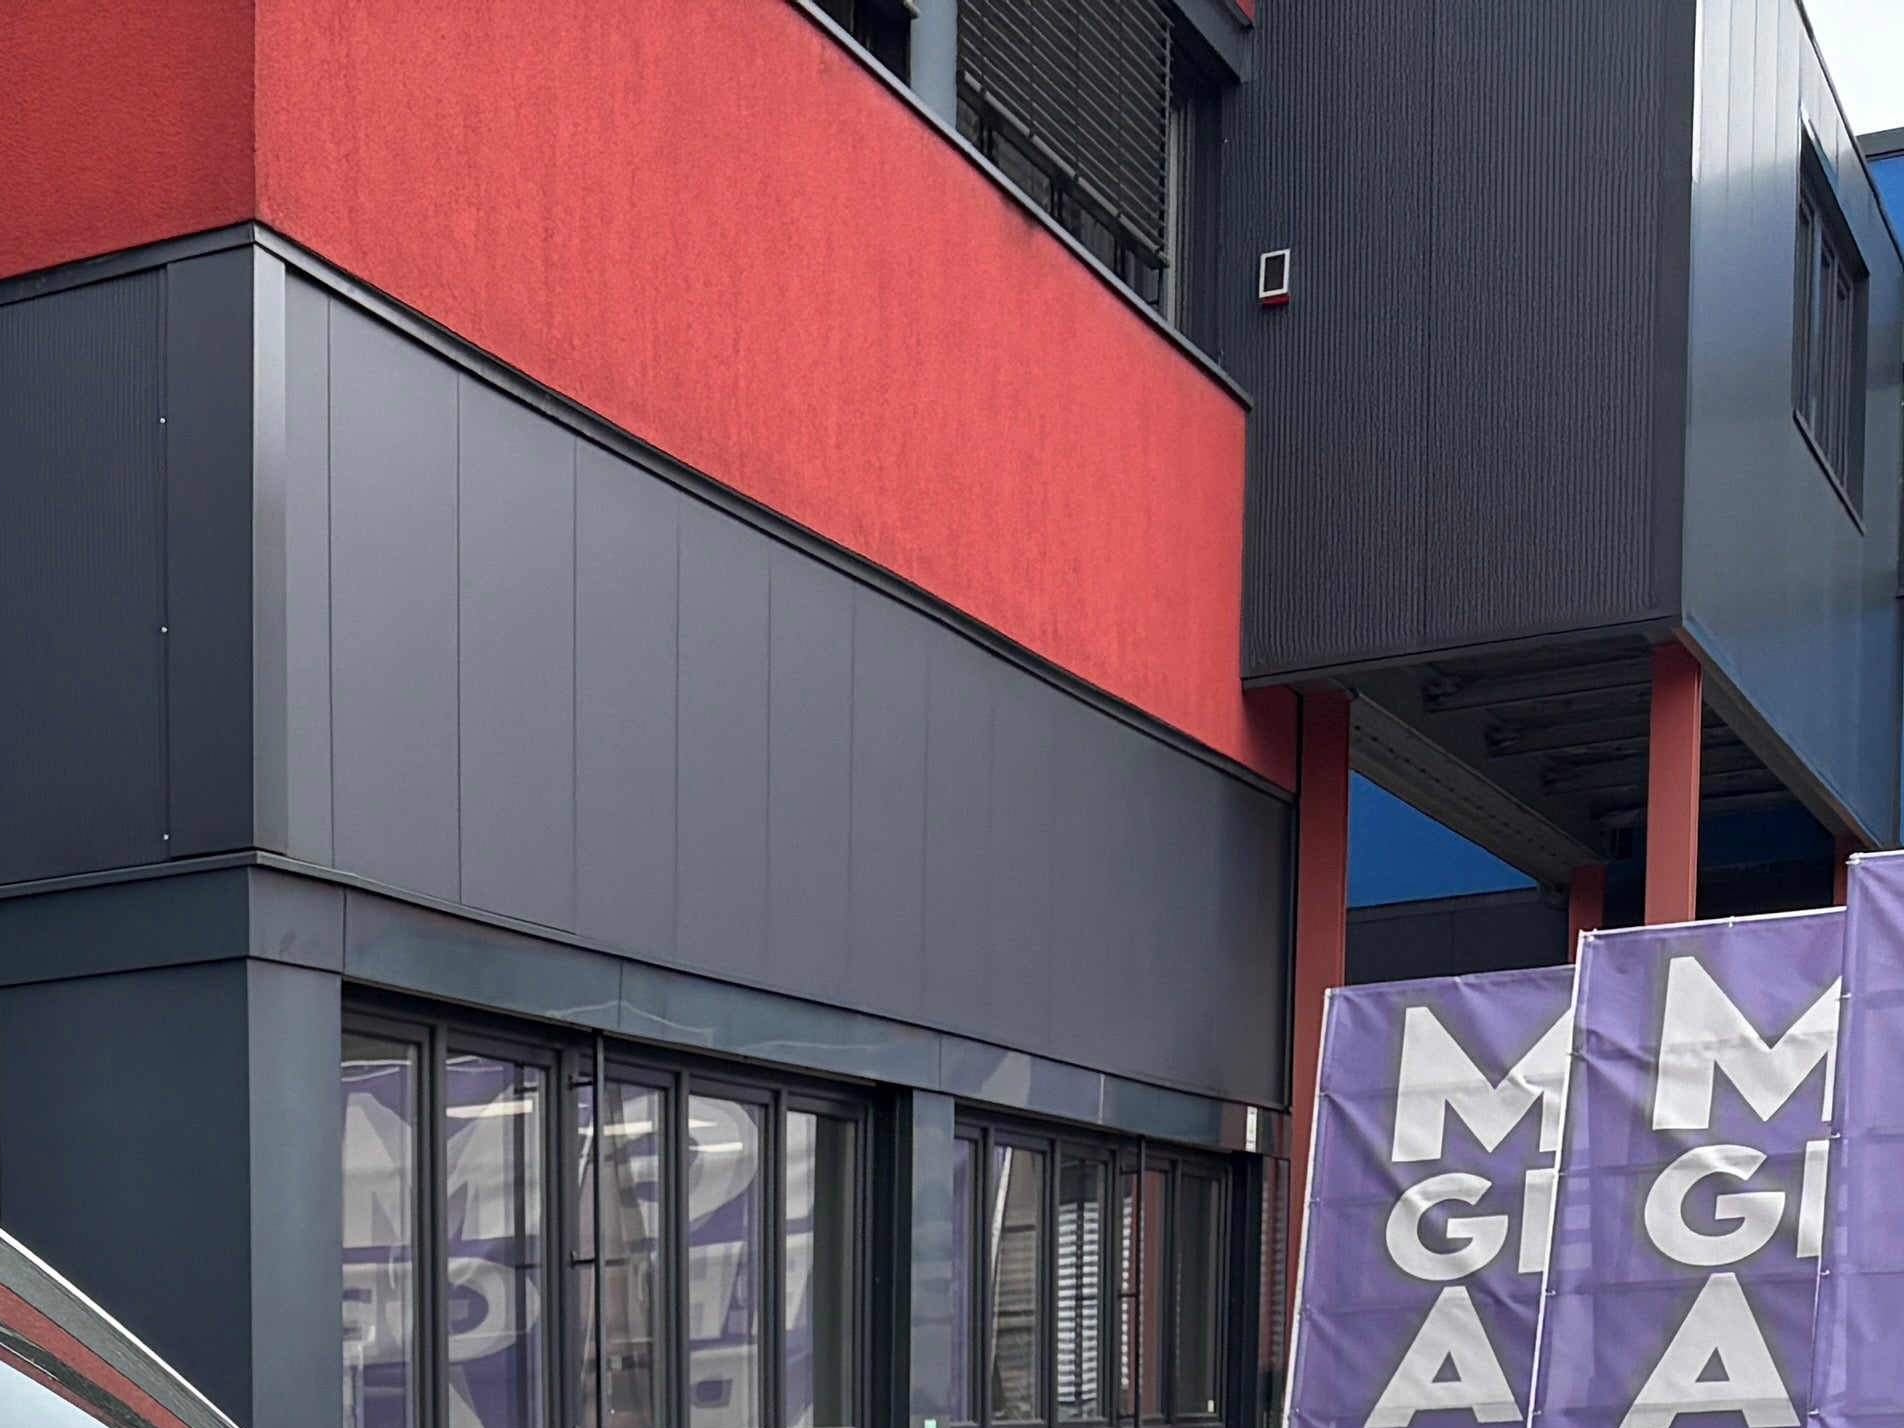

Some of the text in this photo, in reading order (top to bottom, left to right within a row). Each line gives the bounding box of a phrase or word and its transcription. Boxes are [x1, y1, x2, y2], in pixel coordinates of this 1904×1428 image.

[1392, 1006, 1574, 1162] M
[1653, 956, 1842, 1130] M
[1364, 1286, 1523, 1428] A
